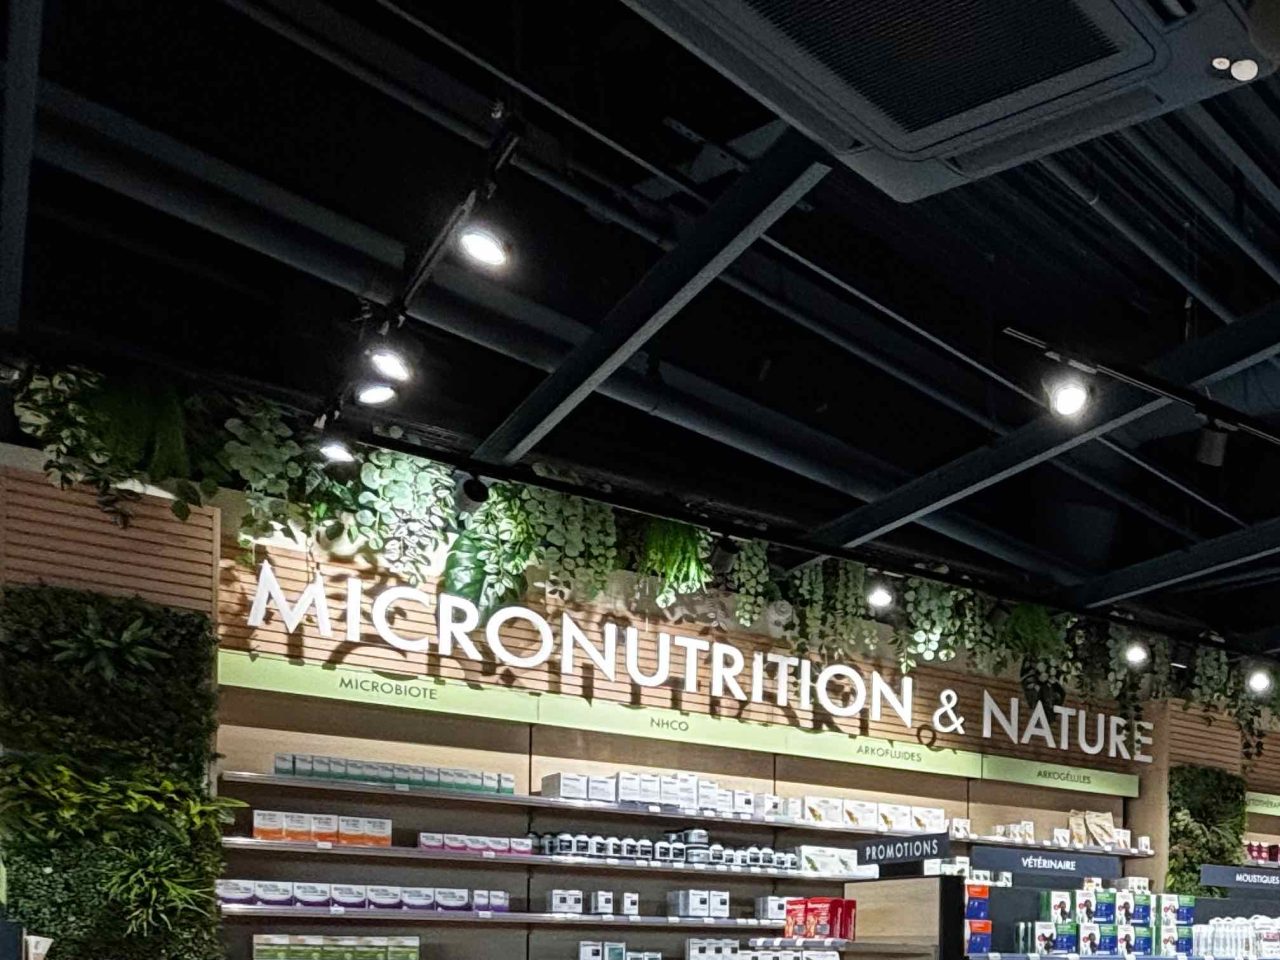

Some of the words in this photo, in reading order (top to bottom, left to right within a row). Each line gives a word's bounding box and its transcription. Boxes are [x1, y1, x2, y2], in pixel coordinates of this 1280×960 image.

[247, 560, 912, 728] MICRONUTRITION
[932, 688, 965, 735] &
[983, 690, 1153, 763] NATURE
[339, 676, 438, 700] MICROBIOTE
[650, 716, 690, 732] NHCO
[856, 745, 923, 762] ARKOFLUIDES
[865, 838, 939, 862] PROMOTIONS
[1021, 855, 1077, 872] VÉTÉRINAIRE
[1235, 873, 1280, 885] MOUSTIQUES
